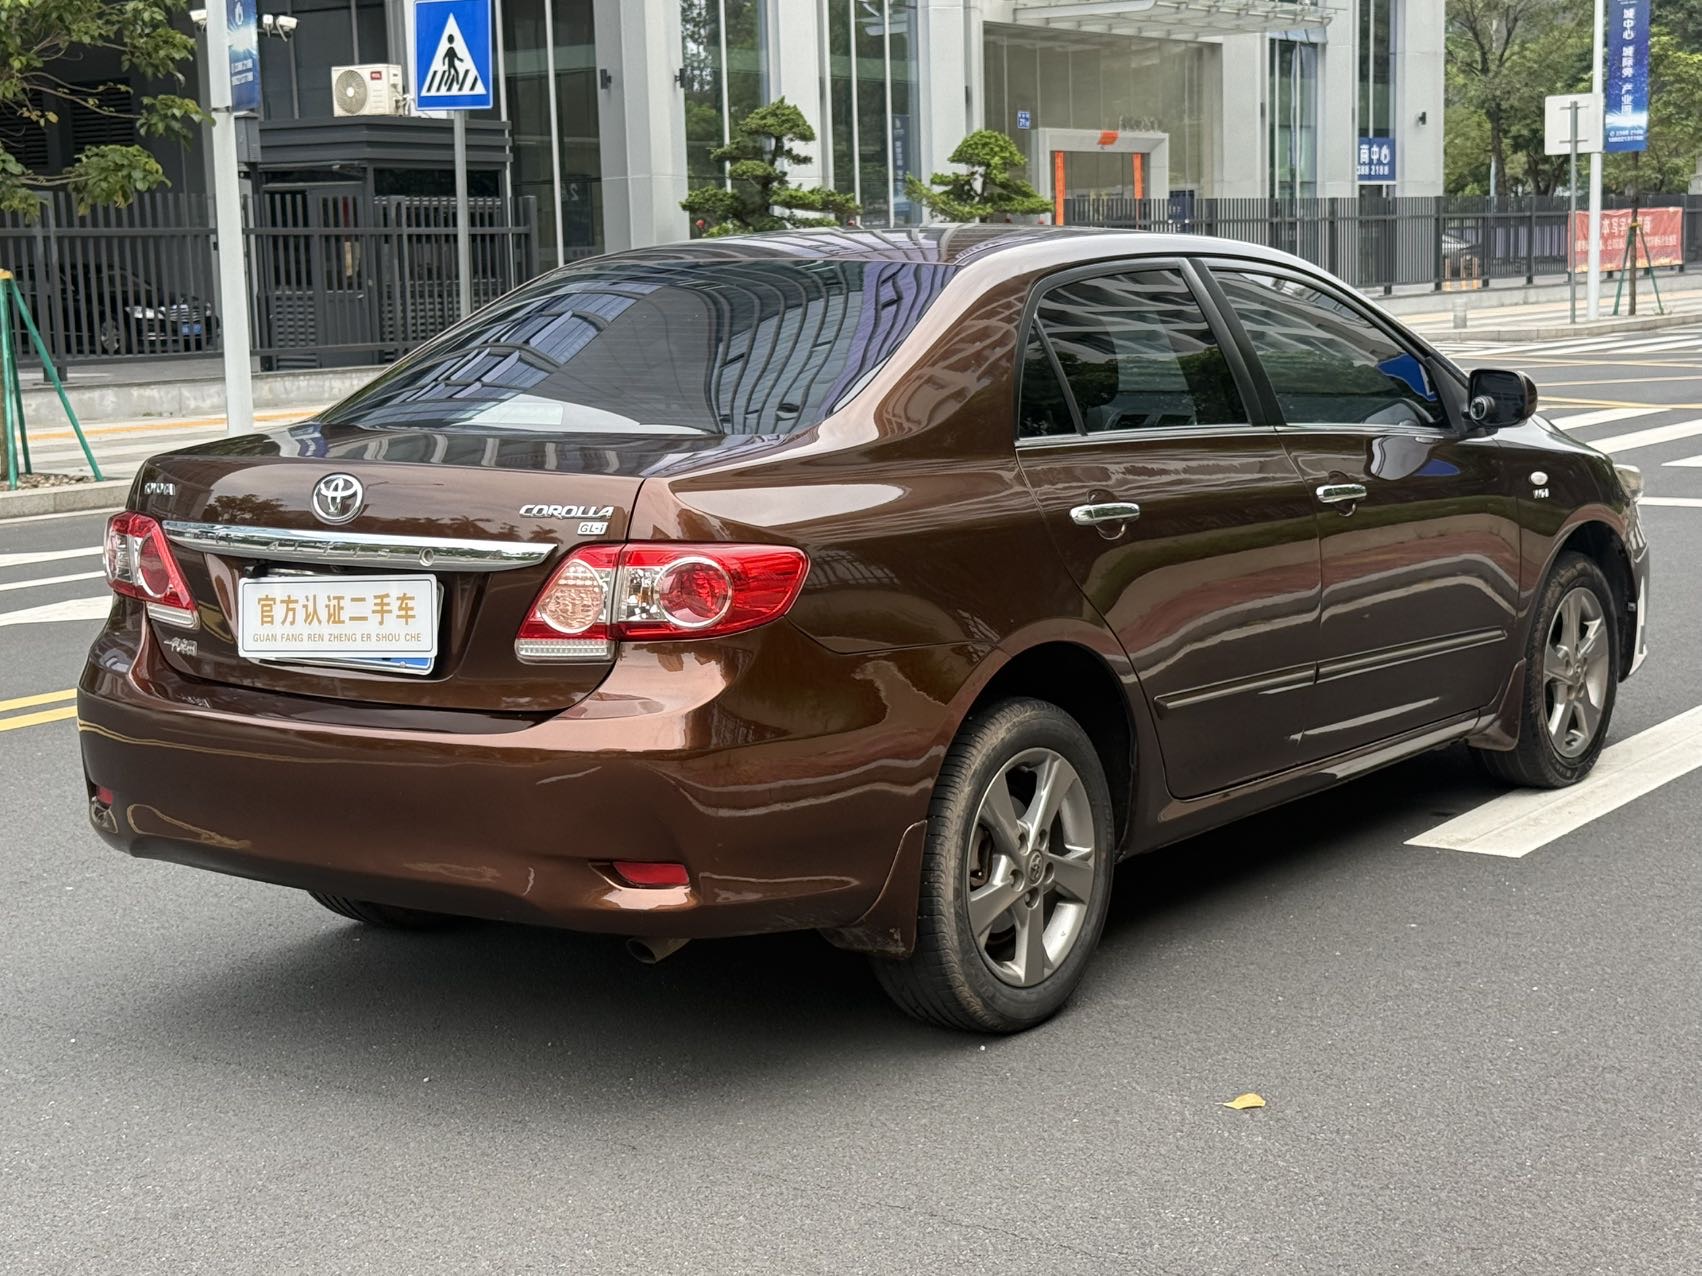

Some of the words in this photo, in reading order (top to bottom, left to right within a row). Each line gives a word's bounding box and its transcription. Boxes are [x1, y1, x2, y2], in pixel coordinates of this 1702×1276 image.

[519, 504, 614, 519] COROLLA
[578, 522, 606, 534] GL-i
[257, 592, 416, 626] 官方认证二手车
[253, 633, 277, 643] GUAN
[281, 633, 303, 643] FANG
[307, 633, 324, 643] REN
[328, 633, 357, 643] ZHENG
[361, 633, 372, 643] ER
[375, 632, 400, 642] SHOU
[404, 632, 421, 642] CHE
